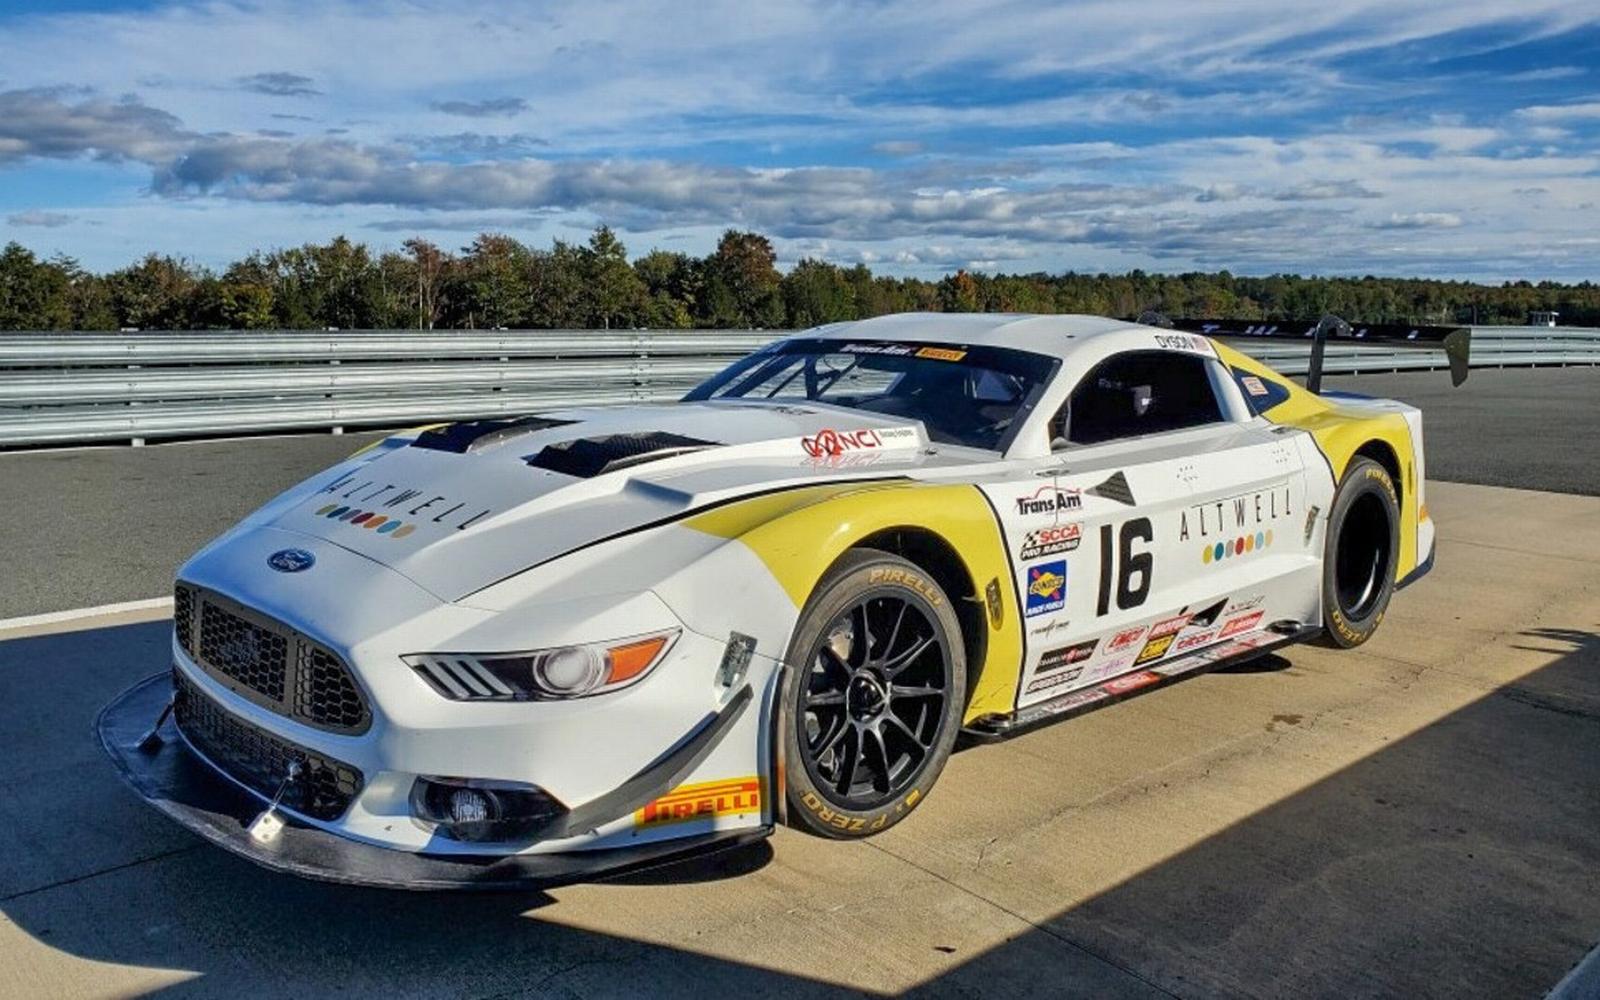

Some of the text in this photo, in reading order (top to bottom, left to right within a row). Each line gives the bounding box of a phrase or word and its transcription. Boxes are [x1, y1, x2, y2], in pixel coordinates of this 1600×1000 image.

[323, 477, 491, 530] ALTWELL
[1180, 488, 1291, 541] ALTWELL
[1039, 523, 1080, 544] SCCA
[868, 568, 943, 607] PIRELLI
[1097, 517, 1153, 617] 16
